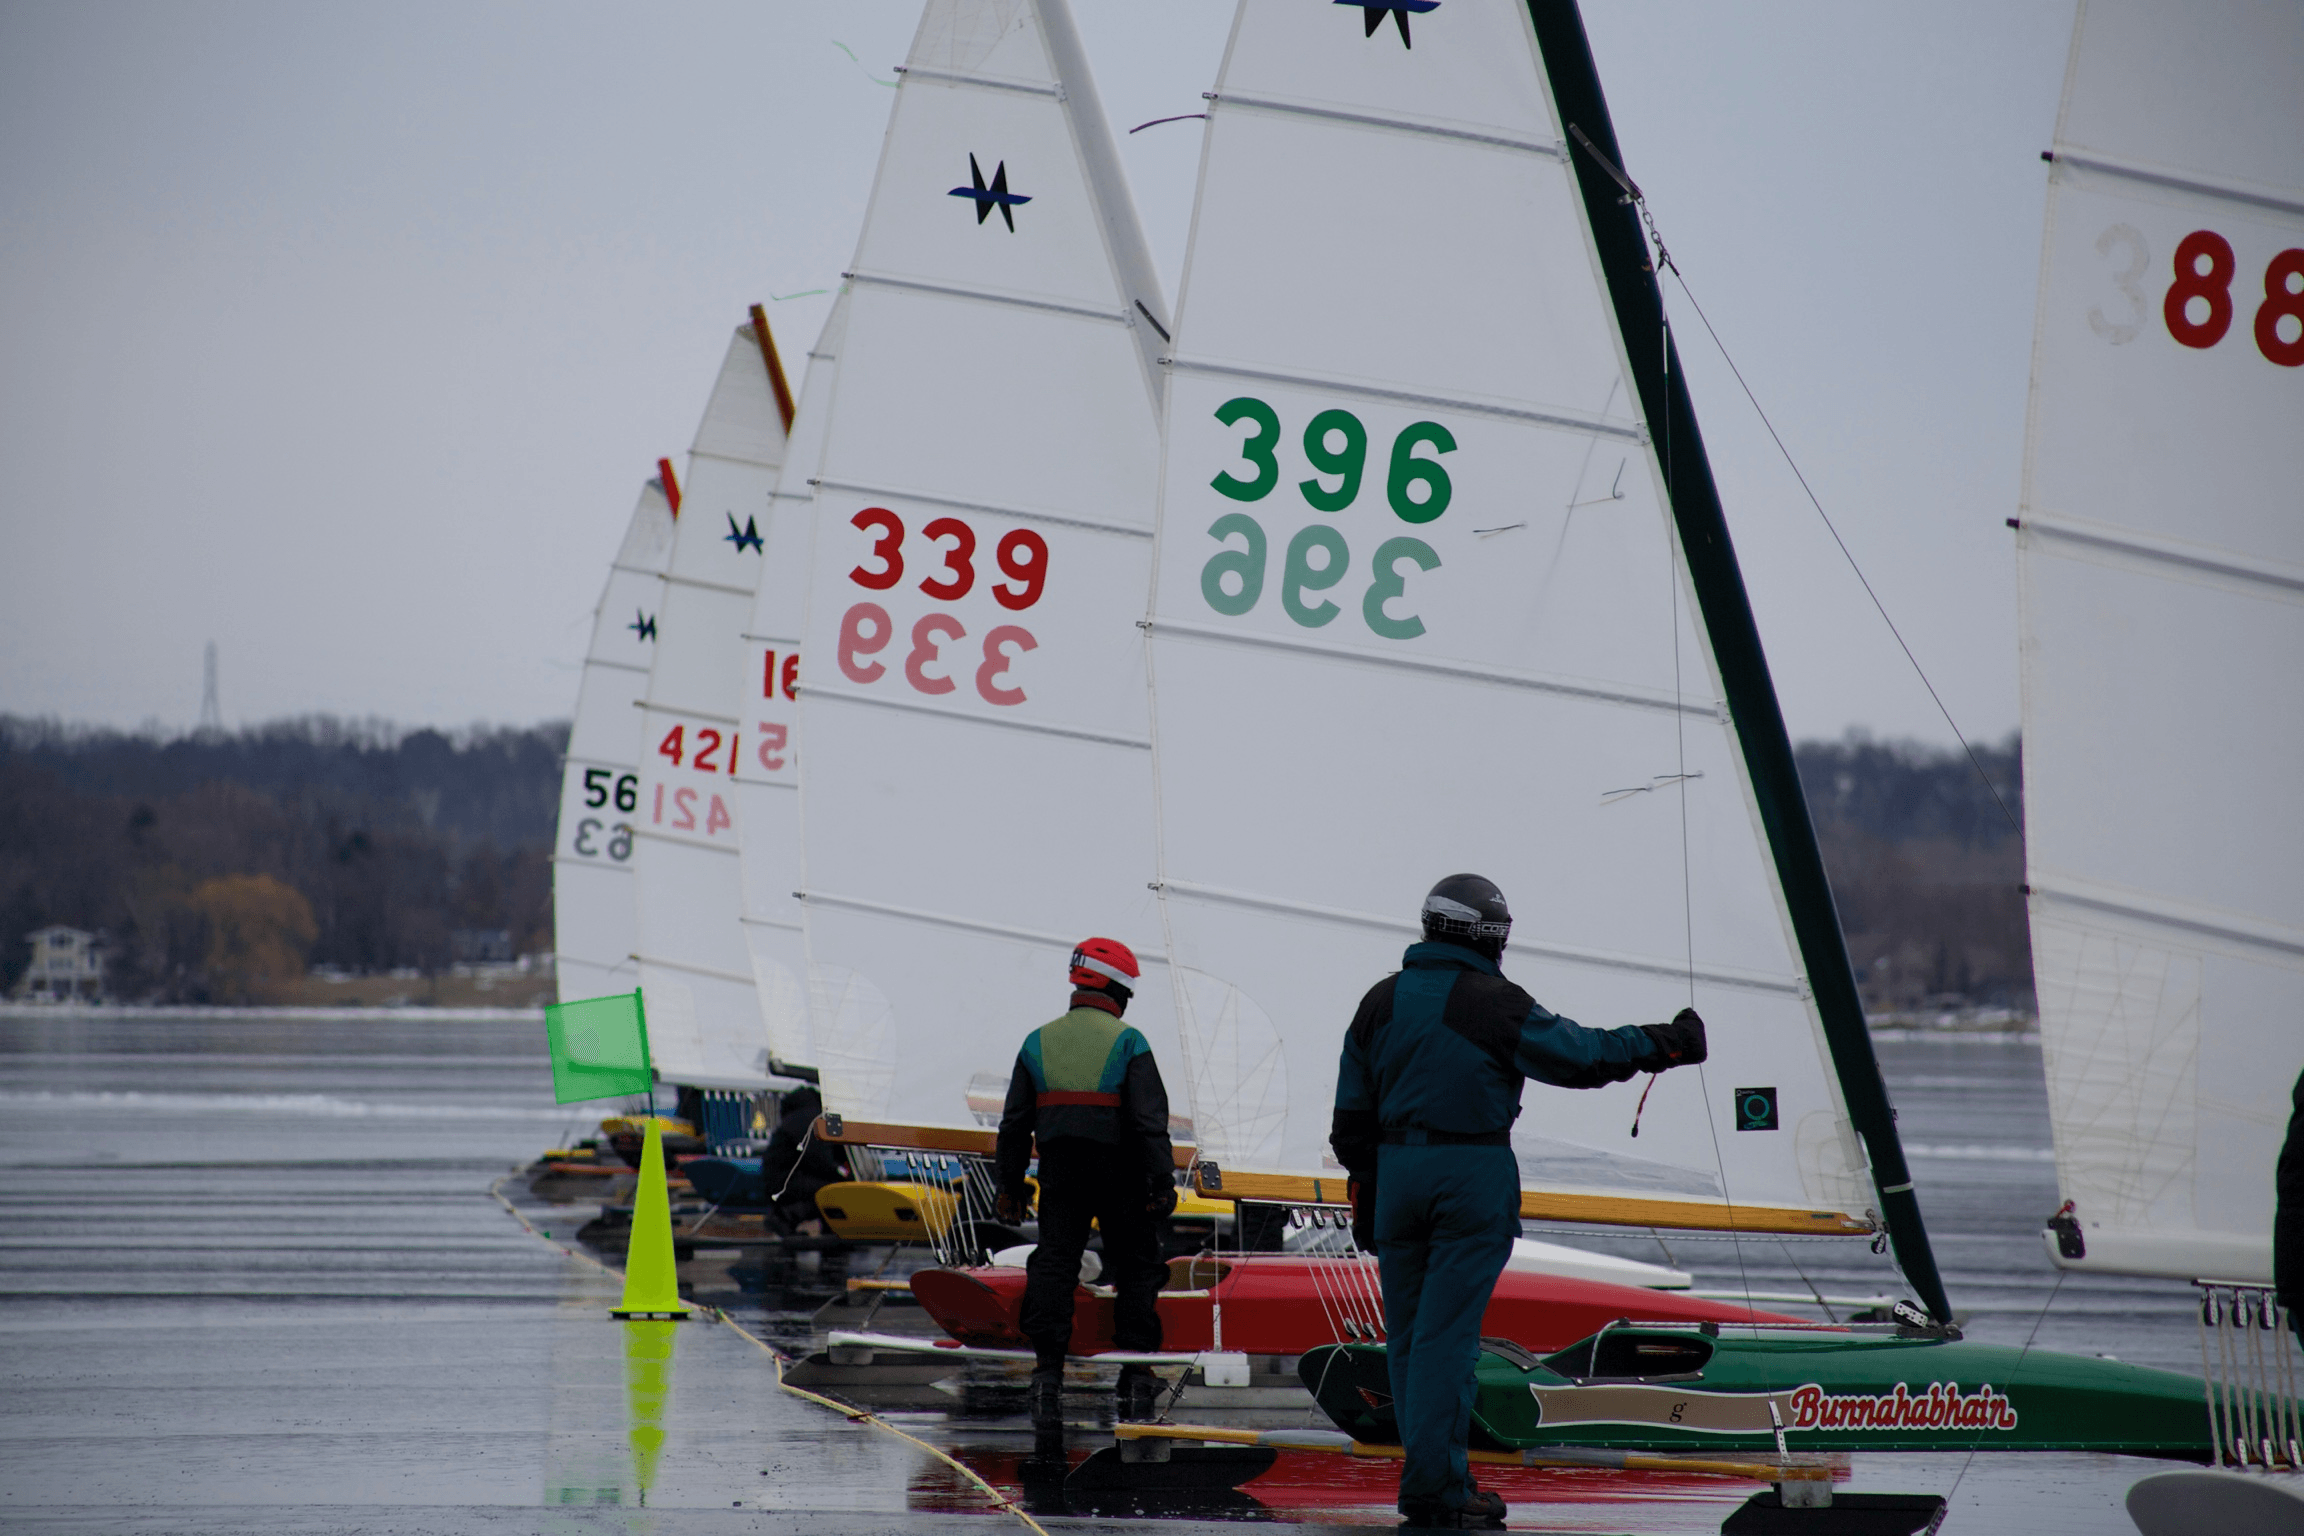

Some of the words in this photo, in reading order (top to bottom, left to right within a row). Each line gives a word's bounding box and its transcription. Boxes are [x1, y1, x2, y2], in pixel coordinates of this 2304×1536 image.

[1210, 397, 1458, 524] 396
[849, 507, 1049, 610] 339
[658, 723, 739, 776] 421
[584, 768, 638, 813] 56
[1791, 1382, 2017, 1430] Bunnahabhain
